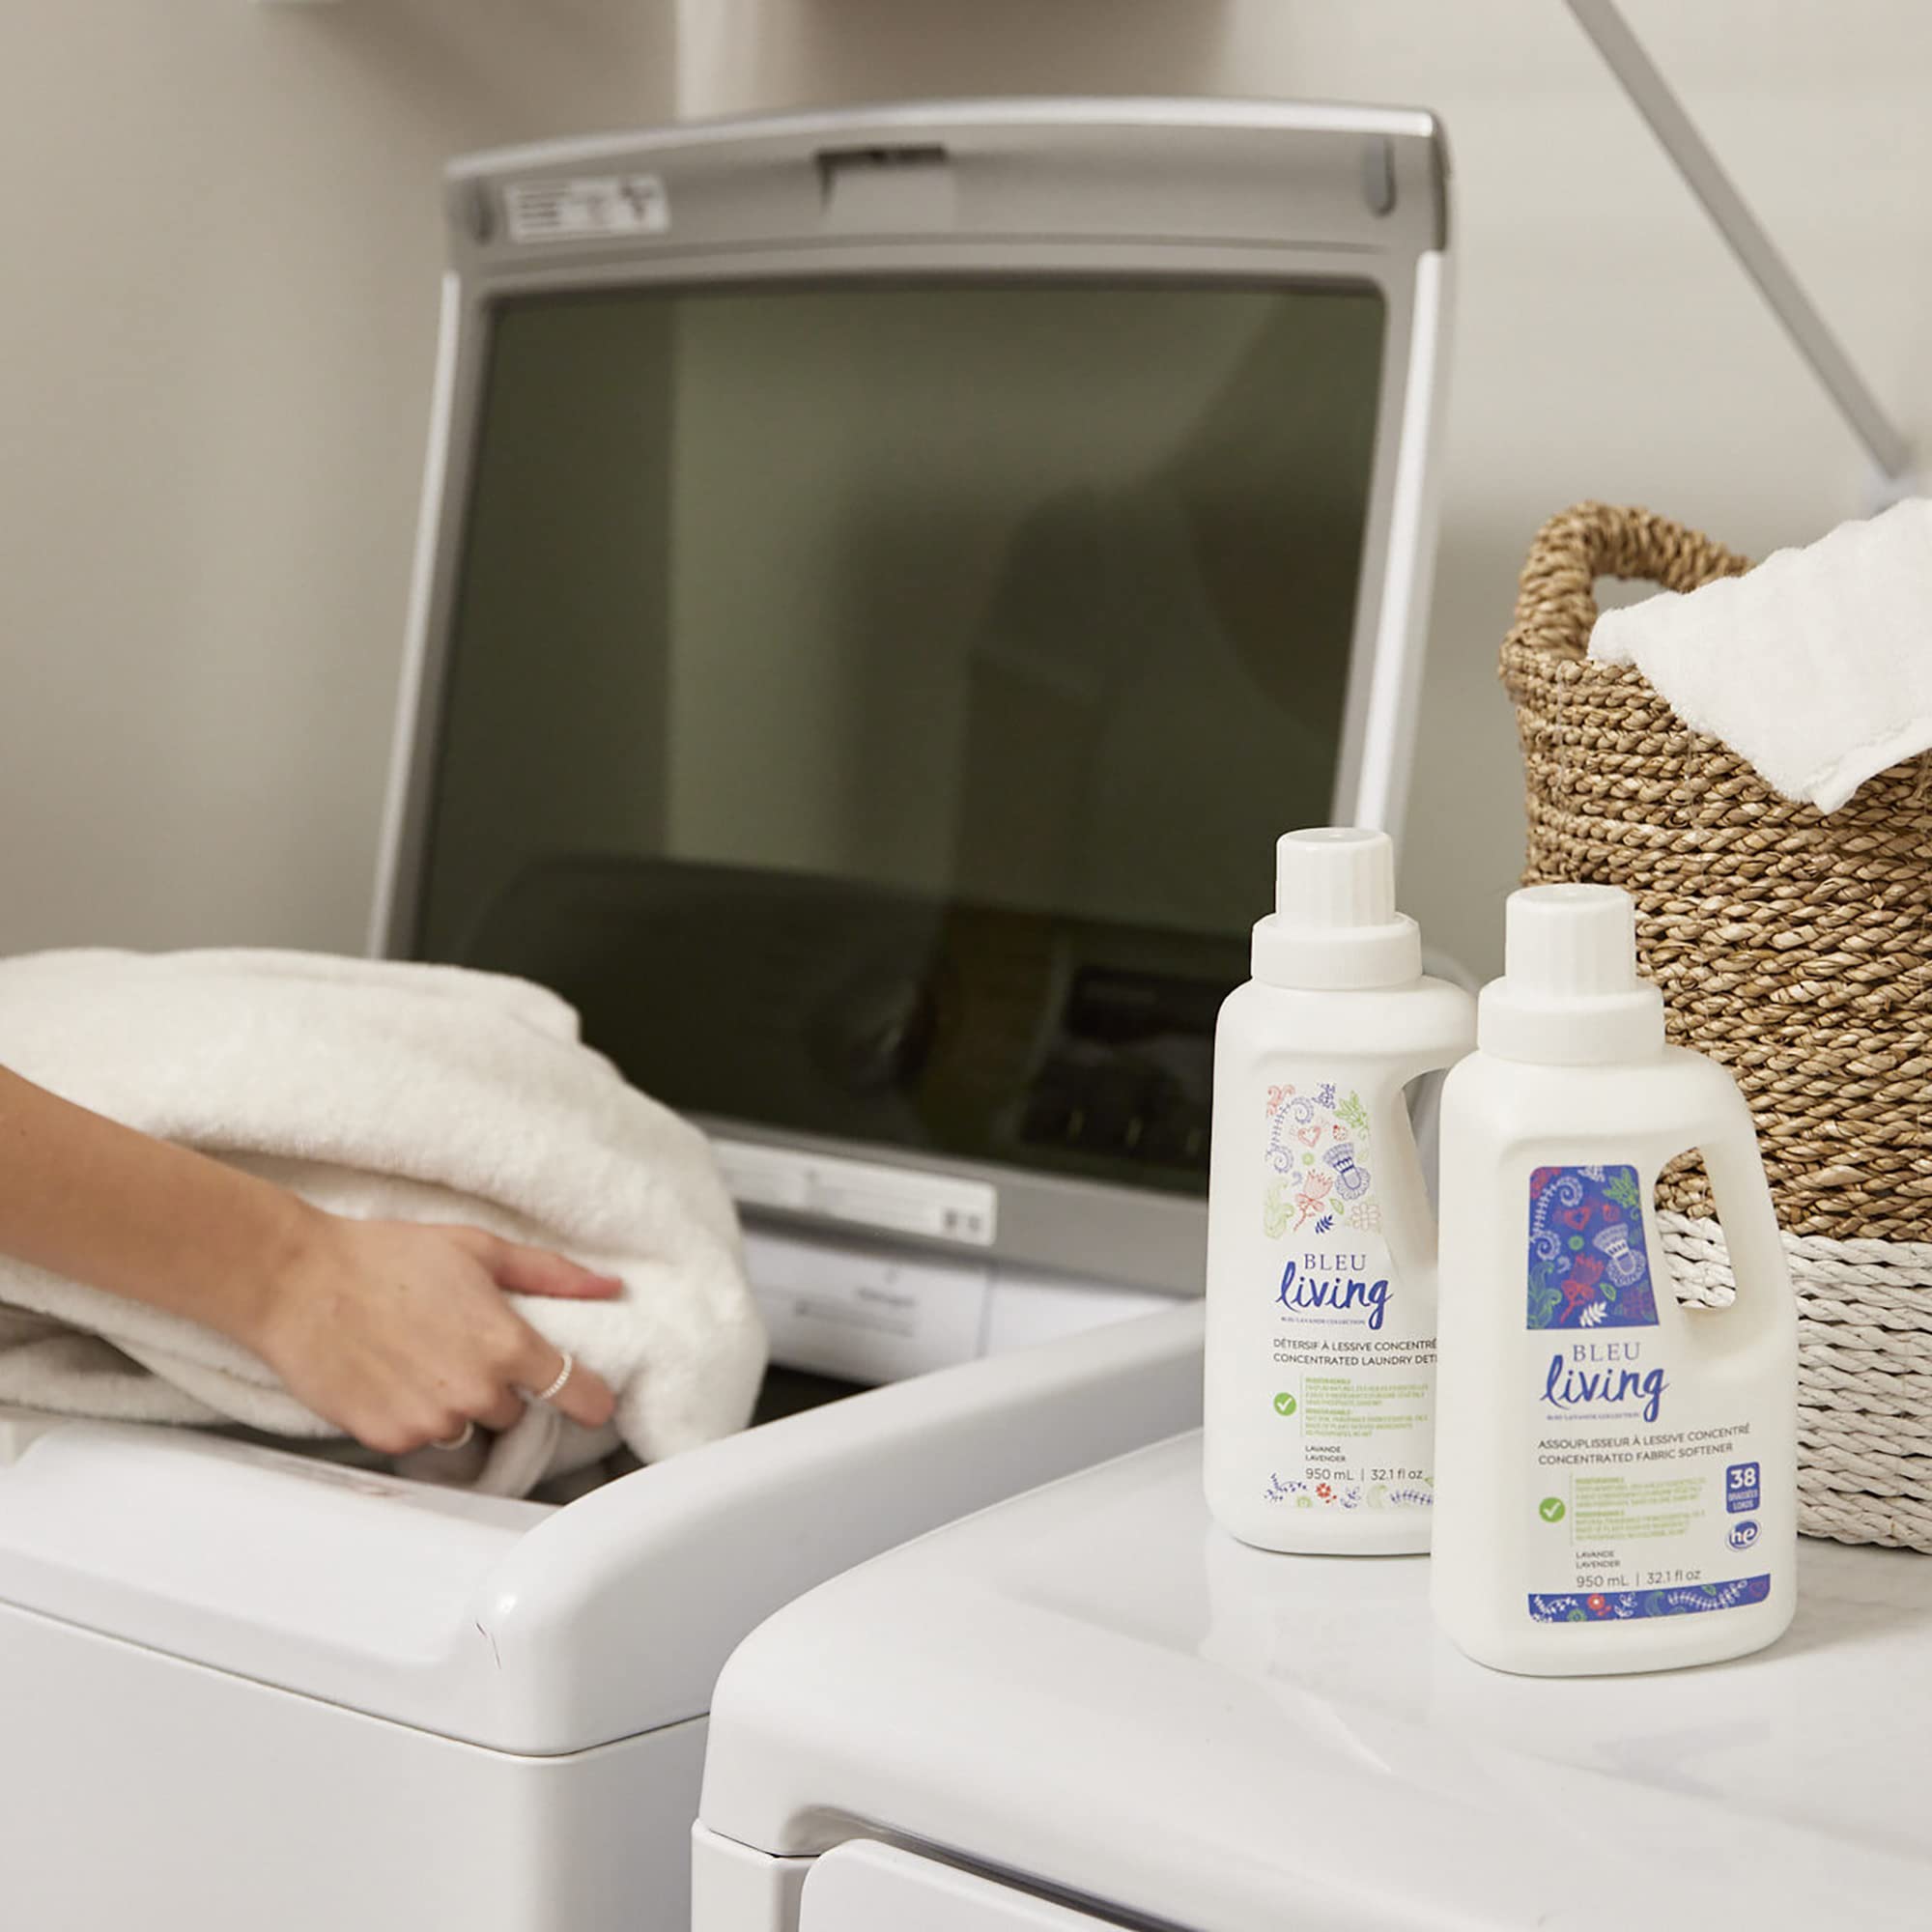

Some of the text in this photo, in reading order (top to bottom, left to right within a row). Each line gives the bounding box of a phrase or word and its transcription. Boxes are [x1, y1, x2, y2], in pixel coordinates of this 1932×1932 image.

[1304, 1254, 1367, 1271] BLEU
[1275, 1261, 1394, 1330] living
[1273, 1338, 1437, 1351] DÉTERSIF À LESSIVE CONCENTRÉ
[1573, 1342, 1640, 1362] BLEU
[1273, 1352, 1359, 1366] CONCENTRATED
[1362, 1354, 1412, 1366] LAUNDRY
[1539, 1354, 1670, 1423] living
[1538, 1422, 1750, 1450] ASSOUPLISSEUR À LESSIVE CONCENTRÉ
[1538, 1442, 1734, 1465] CONCENTRATED FABRIC SOFTENER
[1305, 1468, 1331, 1480] 950
[1334, 1469, 1354, 1481] mL
[1371, 1468, 1394, 1481] 32.1
[1407, 1469, 1424, 1480] oz
[1730, 1467, 1757, 1489] 38
[1577, 1575, 1605, 1588] 950
[1606, 1575, 1630, 1587] mL
[1646, 1571, 1671, 1585] 32.1
[1686, 1570, 1701, 1581] oz
